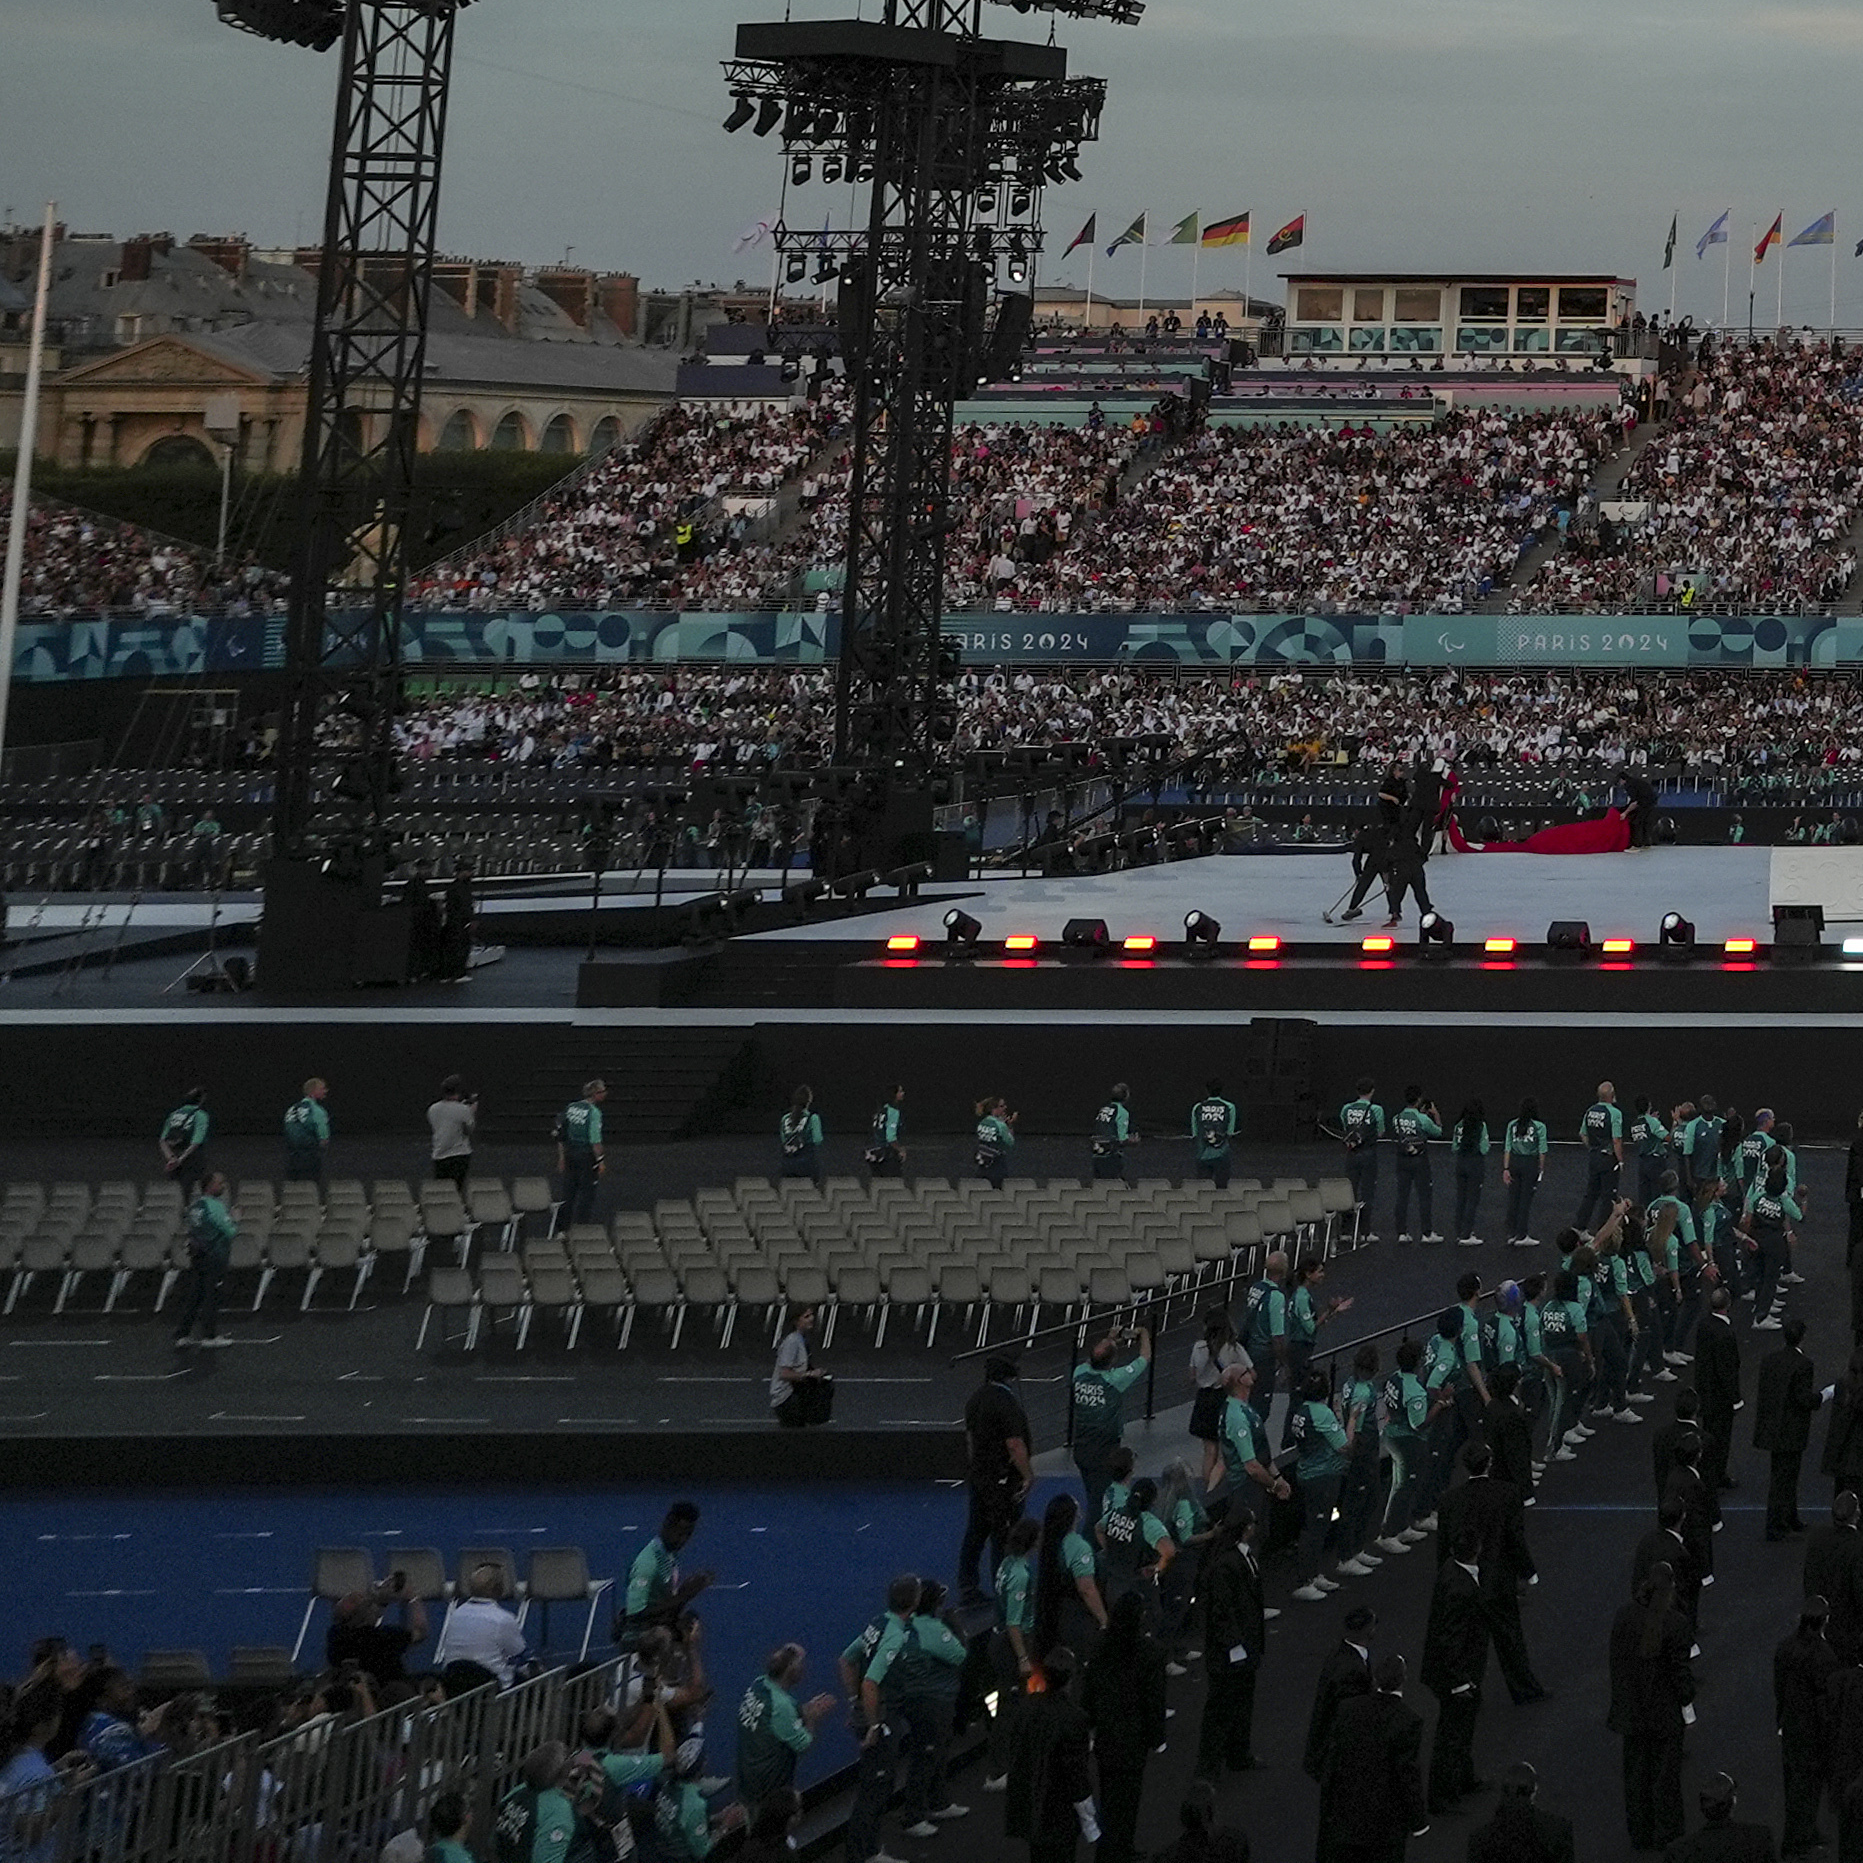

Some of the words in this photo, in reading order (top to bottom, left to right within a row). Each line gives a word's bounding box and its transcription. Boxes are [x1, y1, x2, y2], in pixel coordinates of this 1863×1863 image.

[1023, 633, 1088, 650] 2024
[1517, 634, 1590, 651] PARIS
[1602, 634, 1668, 651] 2024
[1075, 1381, 1105, 1397] PARIS
[1074, 1393, 1106, 1408] 2024
[1110, 1511, 1138, 1532] PARIS
